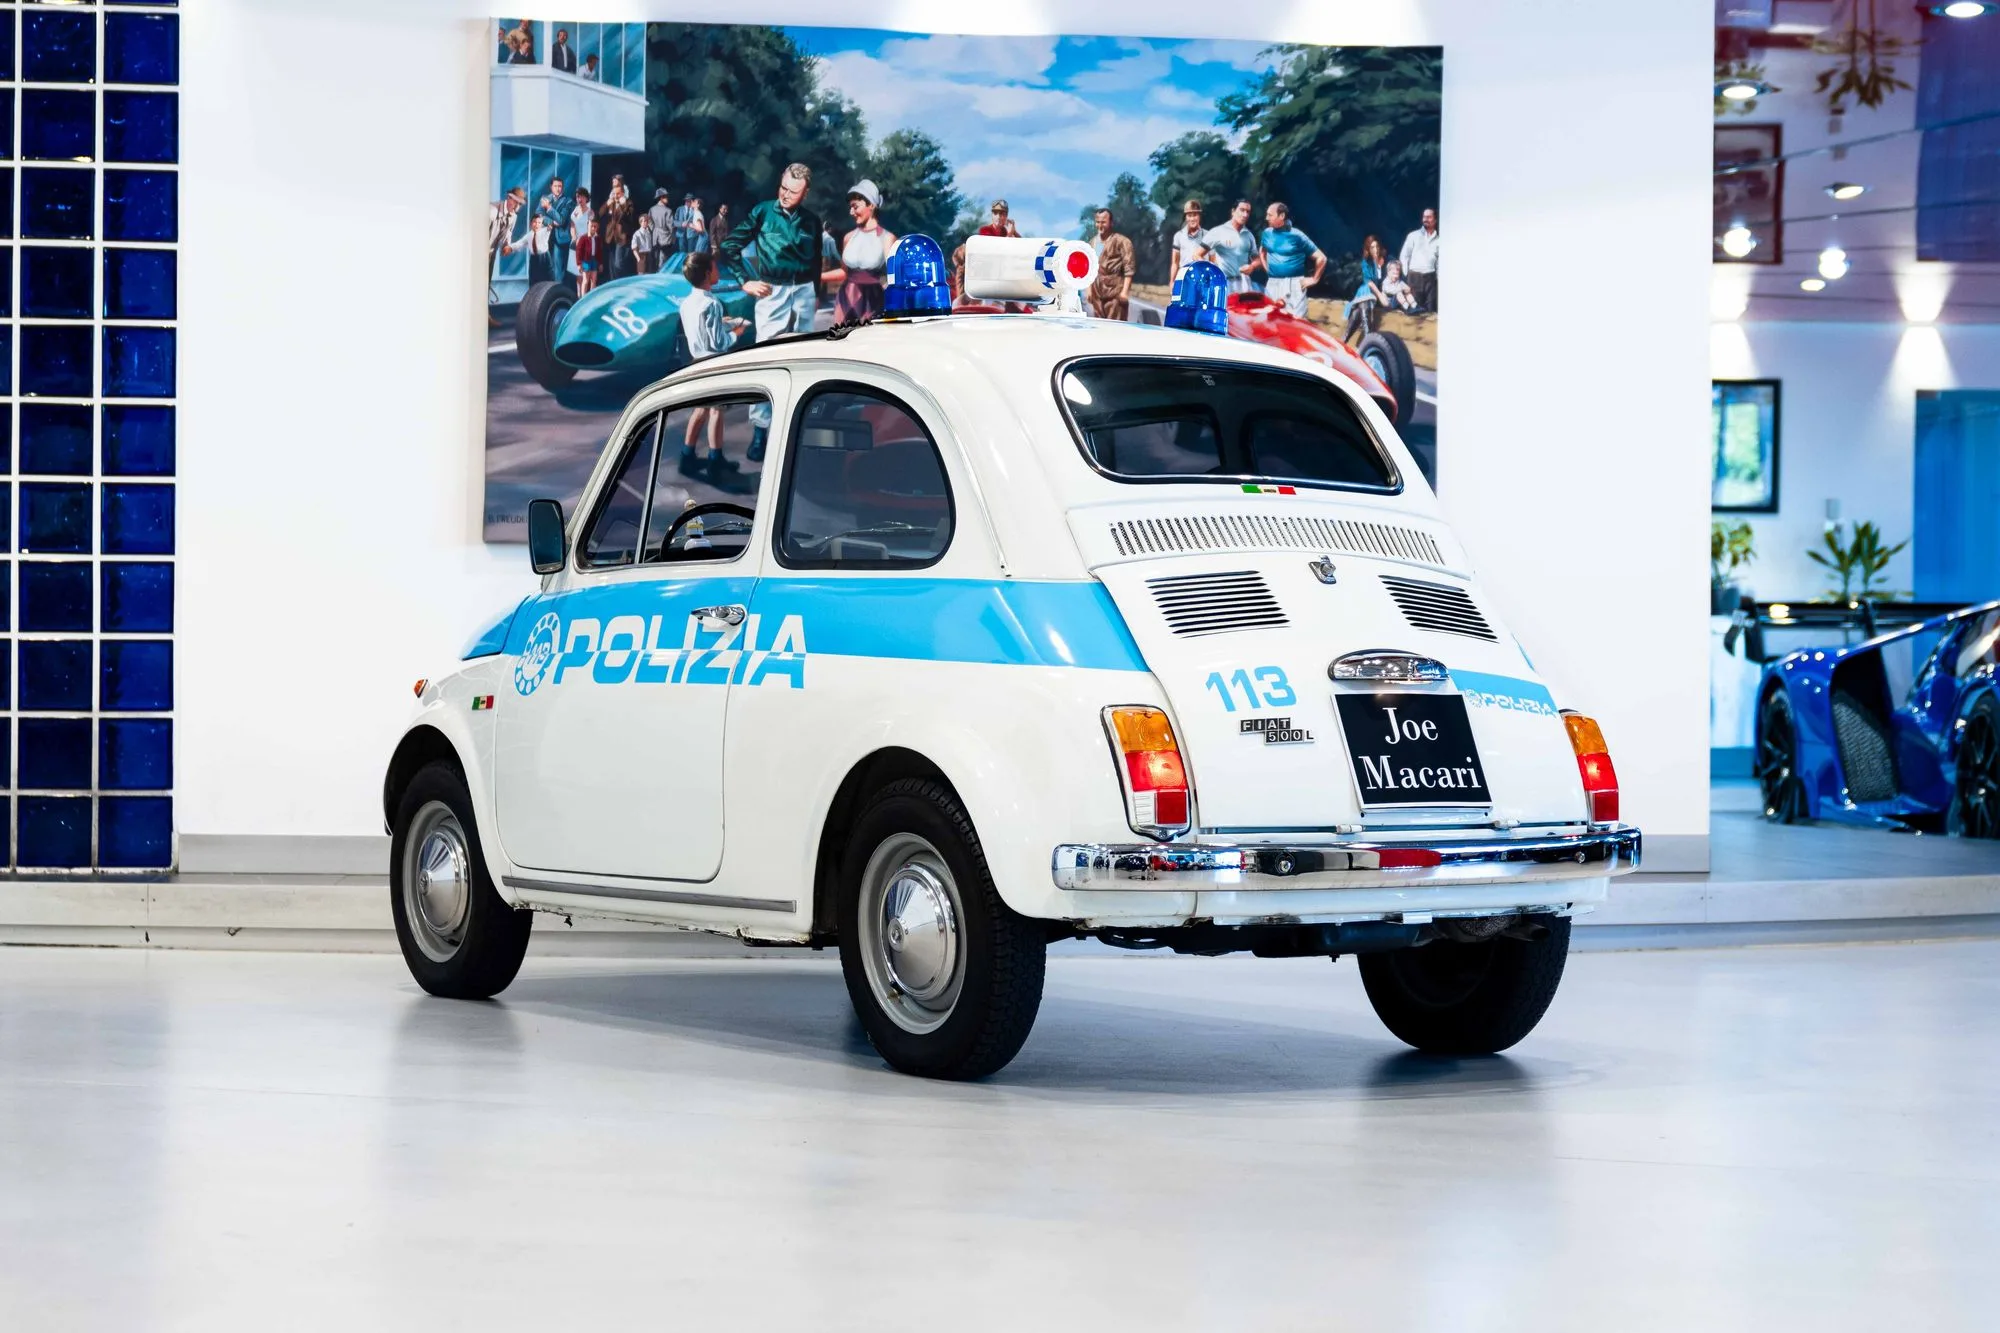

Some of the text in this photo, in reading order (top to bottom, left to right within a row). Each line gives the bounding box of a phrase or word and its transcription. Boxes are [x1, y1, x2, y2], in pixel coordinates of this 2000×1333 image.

[601, 306, 648, 339] 18
[553, 615, 807, 689] POLIZIA
[1205, 665, 1297, 712] 113
[1479, 692, 1557, 718] POLIZIA
[1242, 719, 1289, 731] FIAT
[1382, 707, 1439, 745] Joe
[1358, 755, 1482, 791] Macari
